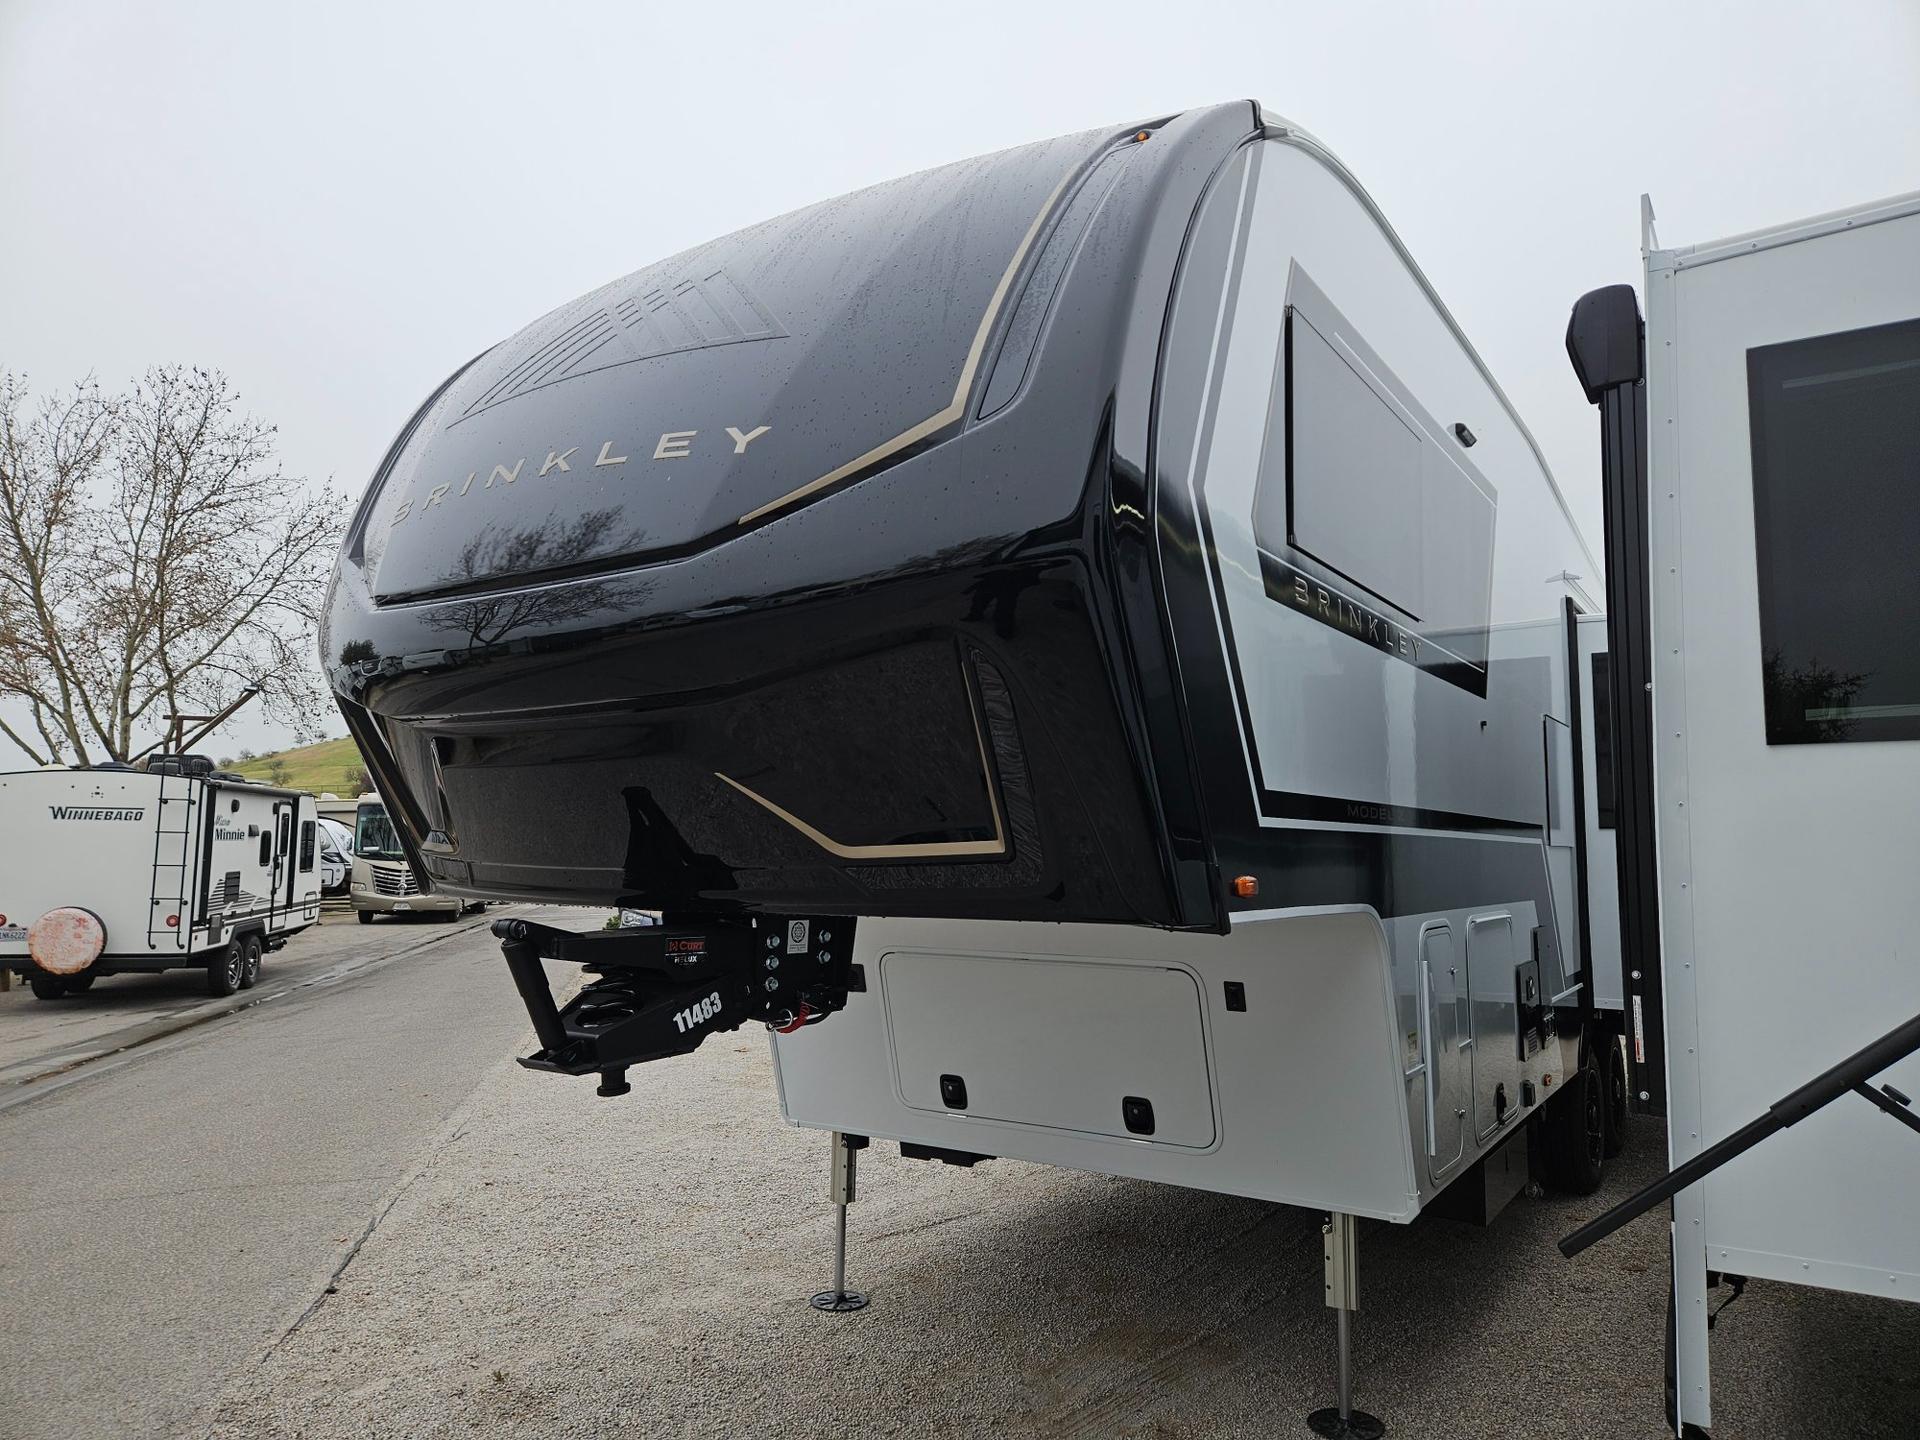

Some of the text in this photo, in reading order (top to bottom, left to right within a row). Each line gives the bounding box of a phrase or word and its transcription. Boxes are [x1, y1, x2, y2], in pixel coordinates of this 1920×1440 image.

[389, 425, 772, 527] BRINKLEY
[1293, 576, 1422, 661] BRINKLEY
[215, 827, 245, 841] Minnie
[672, 991, 722, 1033] 11483
